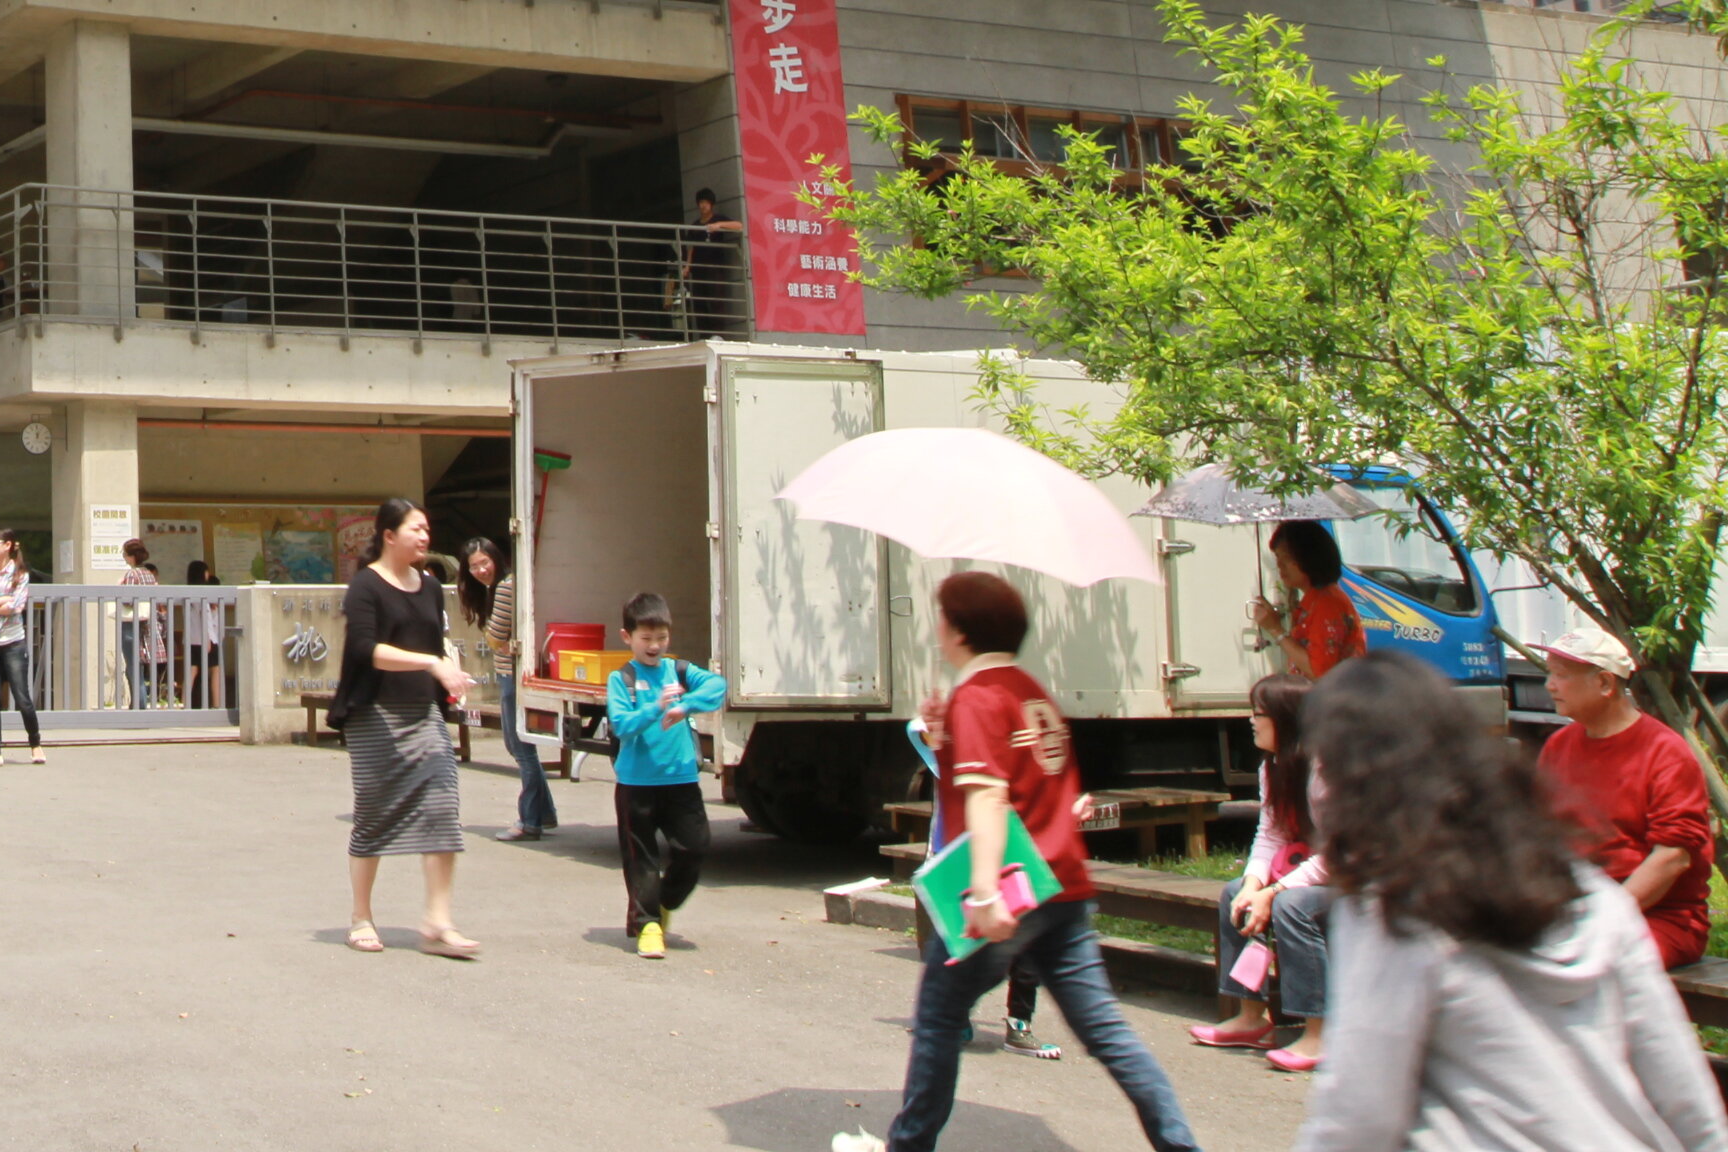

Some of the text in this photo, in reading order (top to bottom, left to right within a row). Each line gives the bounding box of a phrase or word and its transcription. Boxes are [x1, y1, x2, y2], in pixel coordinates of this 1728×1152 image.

[774, 218, 822, 235] 科學能力
[800, 254, 849, 271] 藝術涵養
[788, 283, 837, 299] 健康生活
[1393, 623, 1442, 644] TURBO
